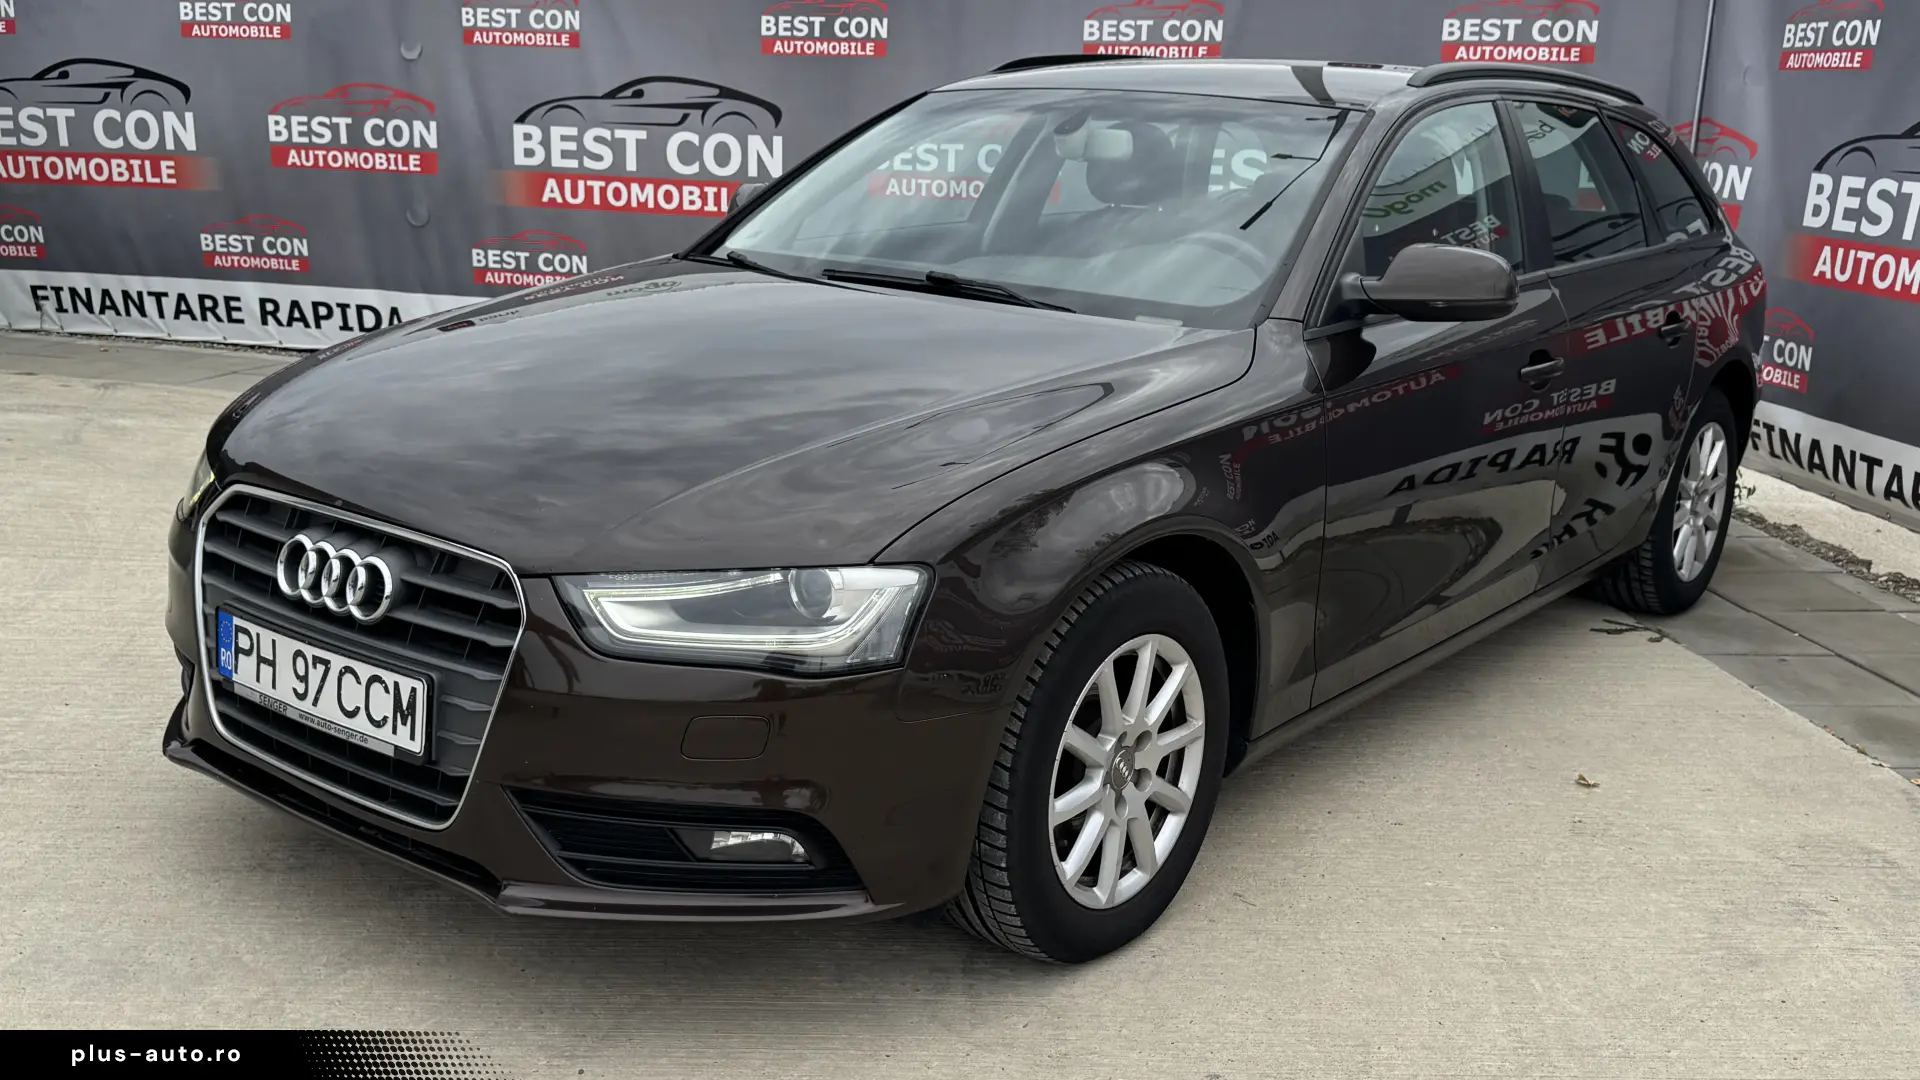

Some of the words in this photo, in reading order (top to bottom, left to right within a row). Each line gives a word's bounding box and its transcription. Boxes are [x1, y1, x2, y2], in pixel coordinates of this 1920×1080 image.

[179, 2, 235, 21] BEST
[243, 3, 291, 22] CON
[461, 7, 521, 28] BEST
[529, 9, 580, 30] CON
[192, 25, 281, 38] AUTOMOBILE
[760, 15, 825, 37] BEST
[834, 16, 888, 38] CON
[1083, 19, 1153, 41] BEST
[1162, 19, 1223, 41] CON
[1442, 18, 1522, 41] BEST
[1532, 19, 1599, 43] CON
[1783, 21, 1829, 48] BEST
[1832, 19, 1881, 47] CON
[473, 31, 570, 46] AUTOMOBILE
[773, 40, 875, 55] AUTOMOBILE
[1097, 45, 1208, 58] AUTOMOBILE
[1455, 46, 1580, 61] AUTOMOBILE
[1786, 51, 1863, 69] AUTOMOBILE
[0, 106, 75, 147] EST
[93, 109, 197, 151] CON
[267, 115, 352, 144] BEST
[363, 118, 438, 149] CON
[287, 149, 421, 172] AUTOMOBILE
[513, 123, 647, 171] BEST
[666, 131, 783, 178] CON
[877, 143, 964, 173] EST
[885, 178, 985, 198] AUTOMO
[1703, 160, 1752, 201] ON
[541, 178, 729, 212] AUTOMOBIL
[0, 224, 45, 243] CON
[200, 233, 255, 253] BEST
[262, 237, 309, 257] CON
[0, 245, 38, 257] OBILE
[472, 249, 530, 270] BEST
[538, 253, 588, 274] CON
[214, 255, 300, 271] AUTOMOBILE
[1812, 245, 1920, 295] AUTOM
[485, 271, 561, 286] AUTOMOB
[30, 284, 245, 325] FINANTARE
[259, 297, 402, 333] RAPIDA
[1773, 338, 1812, 372] CON
[1762, 365, 1800, 389] OBILE
[1750, 418, 1920, 511] FINANTA
[220, 648, 232, 670] RO
[234, 624, 277, 690] PH
[258, 694, 288, 715] SENGER
[299, 711, 369, 745] www.auto-senger.de
